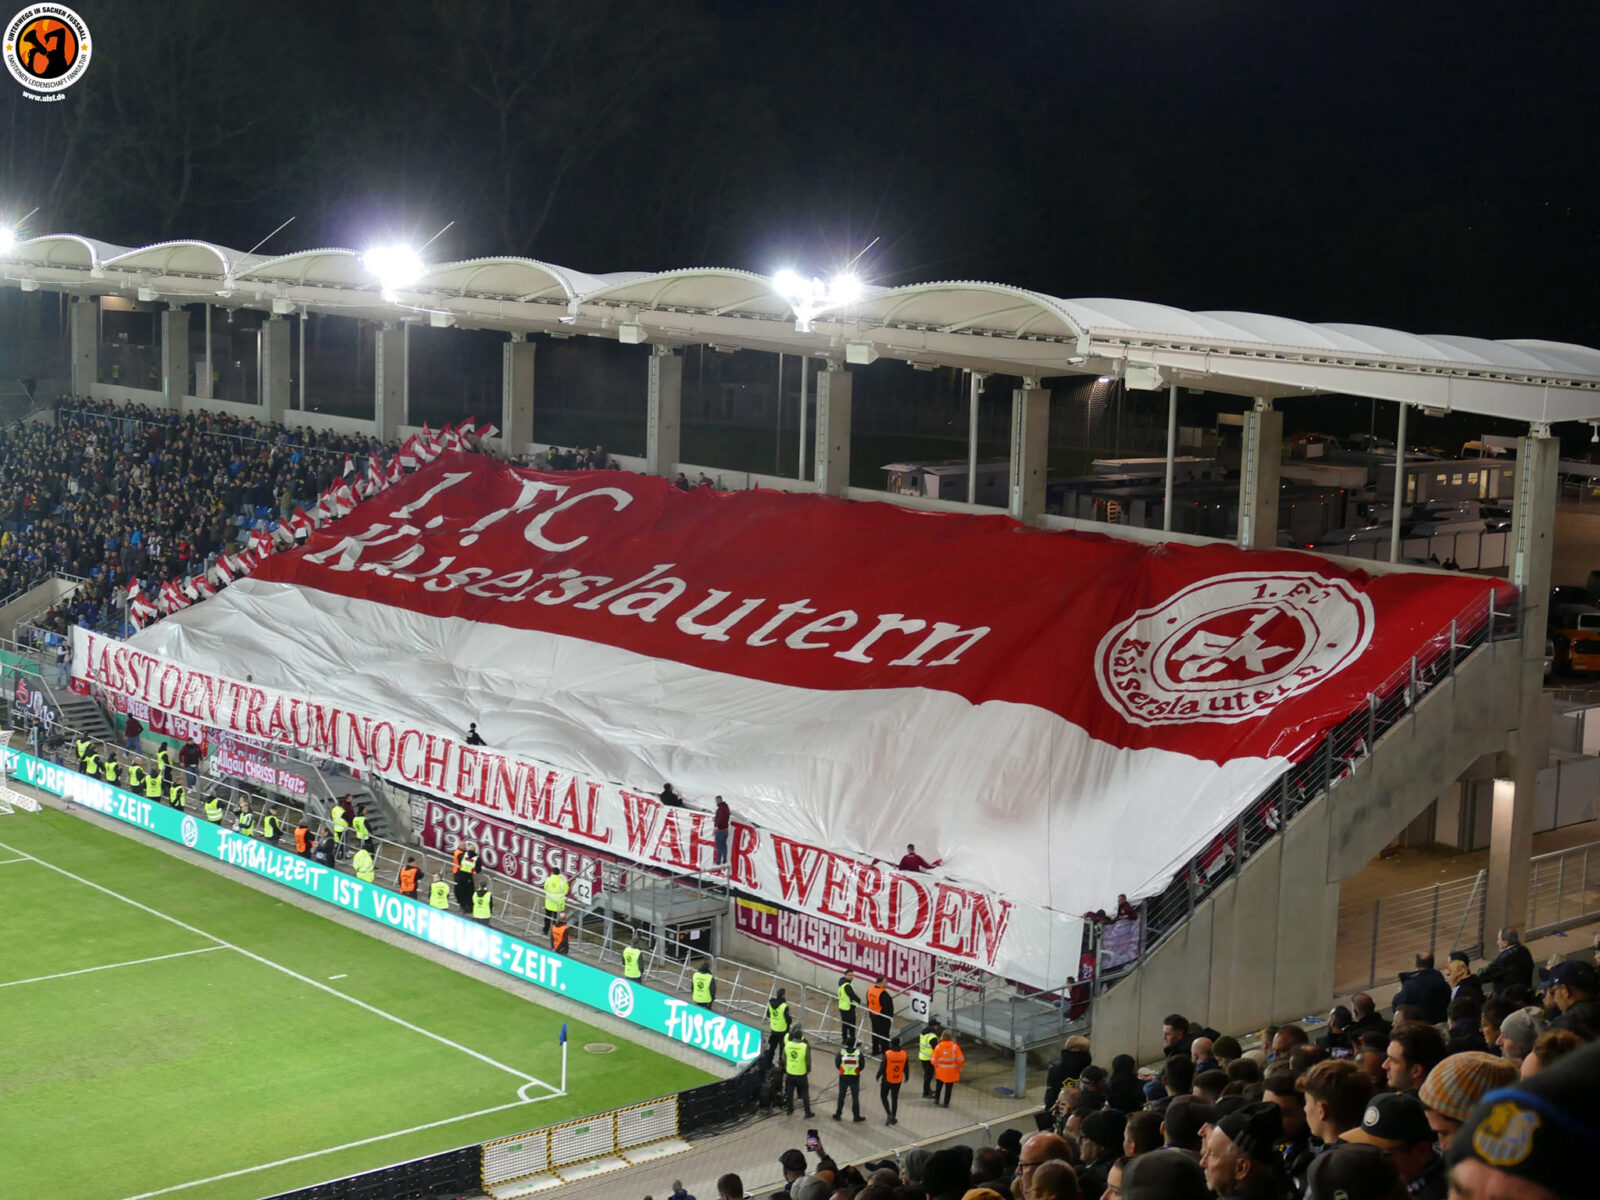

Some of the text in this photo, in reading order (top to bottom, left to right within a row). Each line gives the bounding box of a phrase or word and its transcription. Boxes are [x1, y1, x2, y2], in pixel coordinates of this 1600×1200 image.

[302, 522, 992, 667] Kaiserslautern
[1250, 583, 1278, 600] 1.
[85, 634, 163, 702] LASST
[156, 664, 227, 730] DEN
[229, 681, 342, 760] TRAUM
[343, 711, 453, 793] NOCH
[452, 744, 614, 844] EINMAL
[770, 833, 1017, 967] WERDEN
[430, 804, 597, 882] POKALSIEGER
[333, 876, 362, 910] IST
[577, 884, 590, 899] C2
[911, 998, 928, 1016] C3
